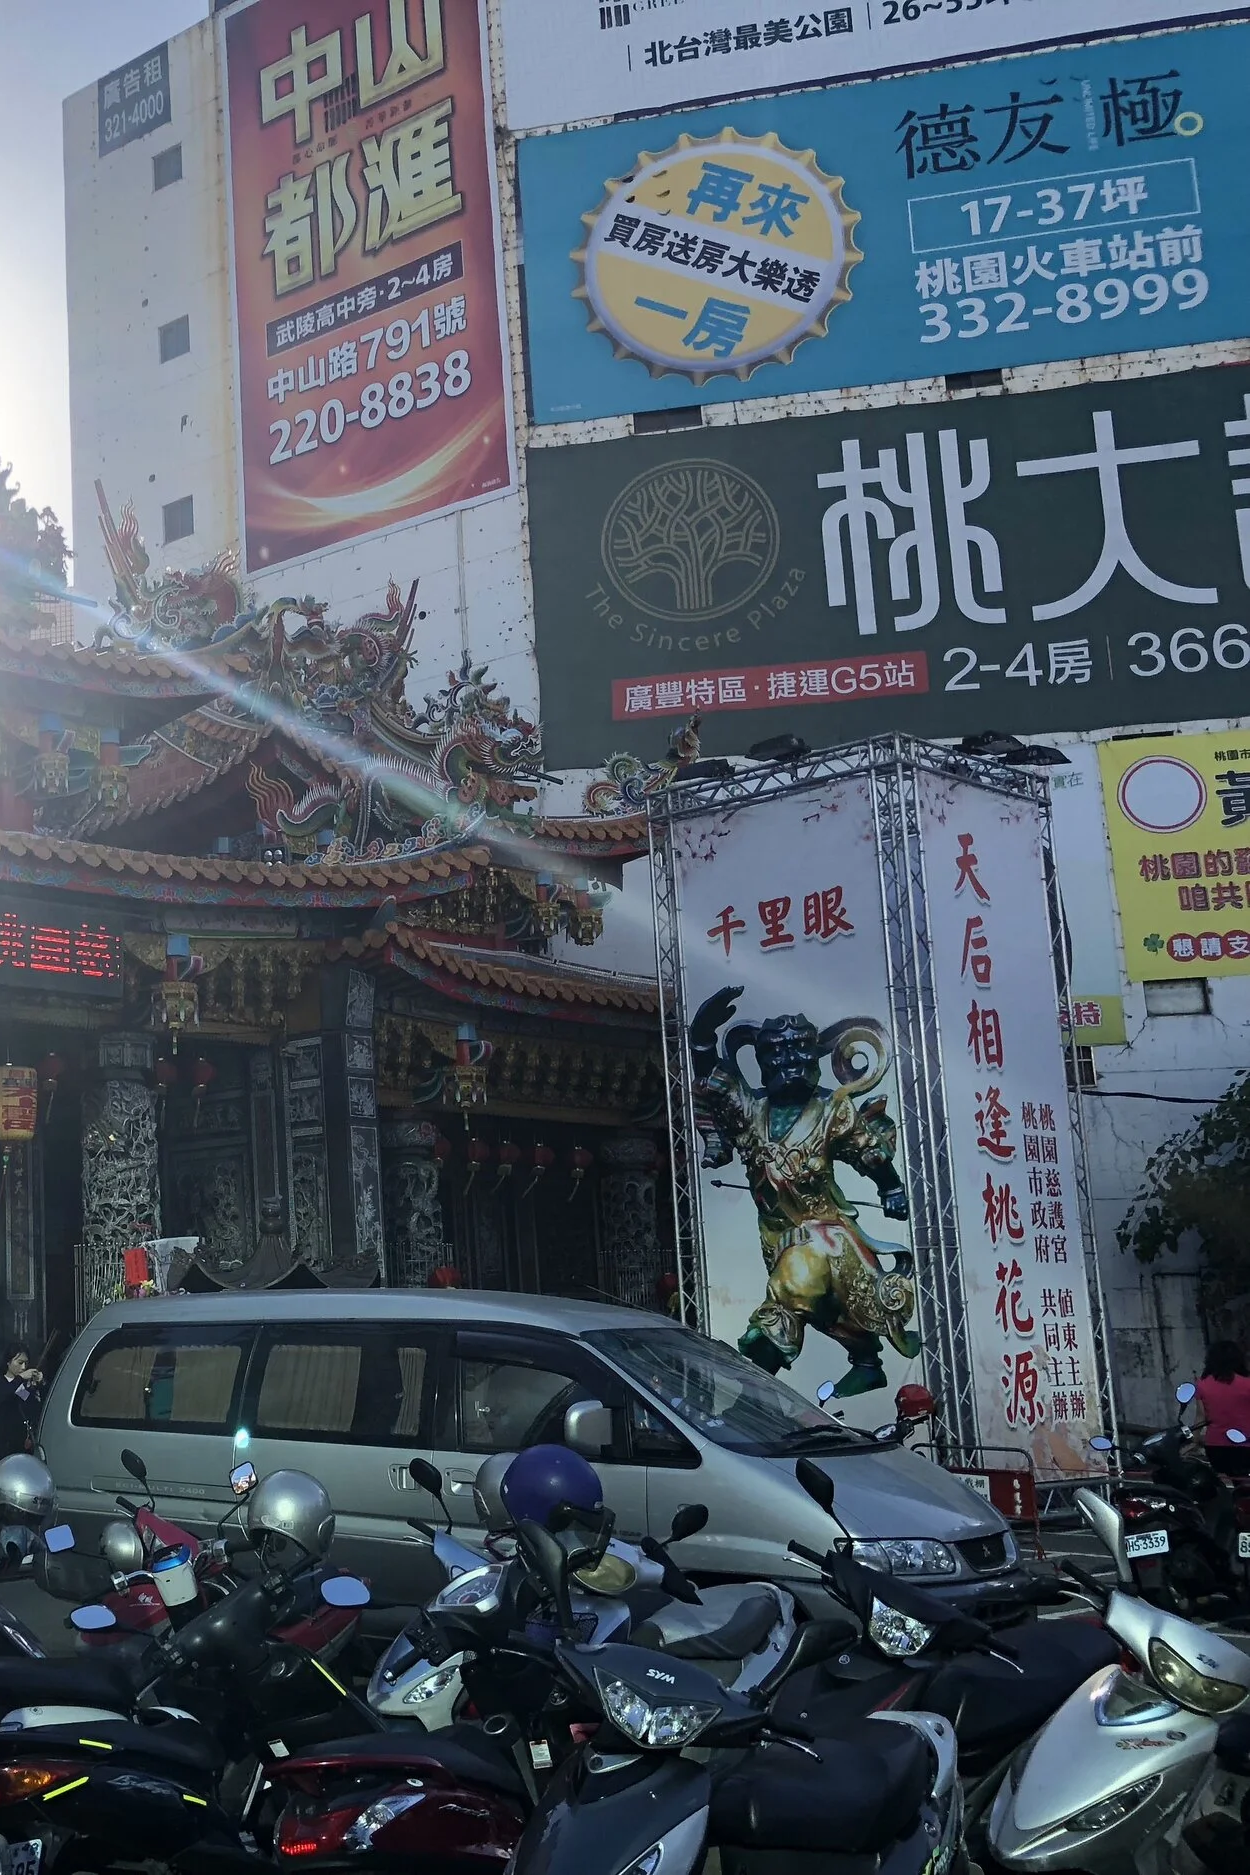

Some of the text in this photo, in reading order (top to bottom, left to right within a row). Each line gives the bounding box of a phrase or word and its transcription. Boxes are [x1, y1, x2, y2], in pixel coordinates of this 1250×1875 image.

[259, 0, 447, 146] 中山
[644, 8, 854, 67] 北台灣最美公園
[104, 55, 162, 111] 廣告租
[104, 90, 164, 142] 321-4000
[684, 162, 811, 239] 再來
[959, 175, 1149, 236] 17-37坪
[603, 212, 823, 304] 買房送房大樂透
[914, 224, 1205, 299] 桃園火車站前
[634, 294, 752, 360] 一房
[918, 268, 1210, 345] 332-8999
[266, 295, 468, 404] 中山路791號
[268, 349, 472, 465] 220-8838
[585, 567, 806, 652] The Sincere Plaza
[942, 639, 1093, 693] 2-4房
[706, 885, 855, 957] 千里眼
[1177, 879, 1250, 912] 咱共
[953, 833, 1045, 1427] 天后相逢桃花源
[1021, 1101, 1051, 1263] 桃園市政府
[1038, 1103, 1068, 1264] 桃園慈護宮
[1040, 1288, 1069, 1421] 共同主辦
